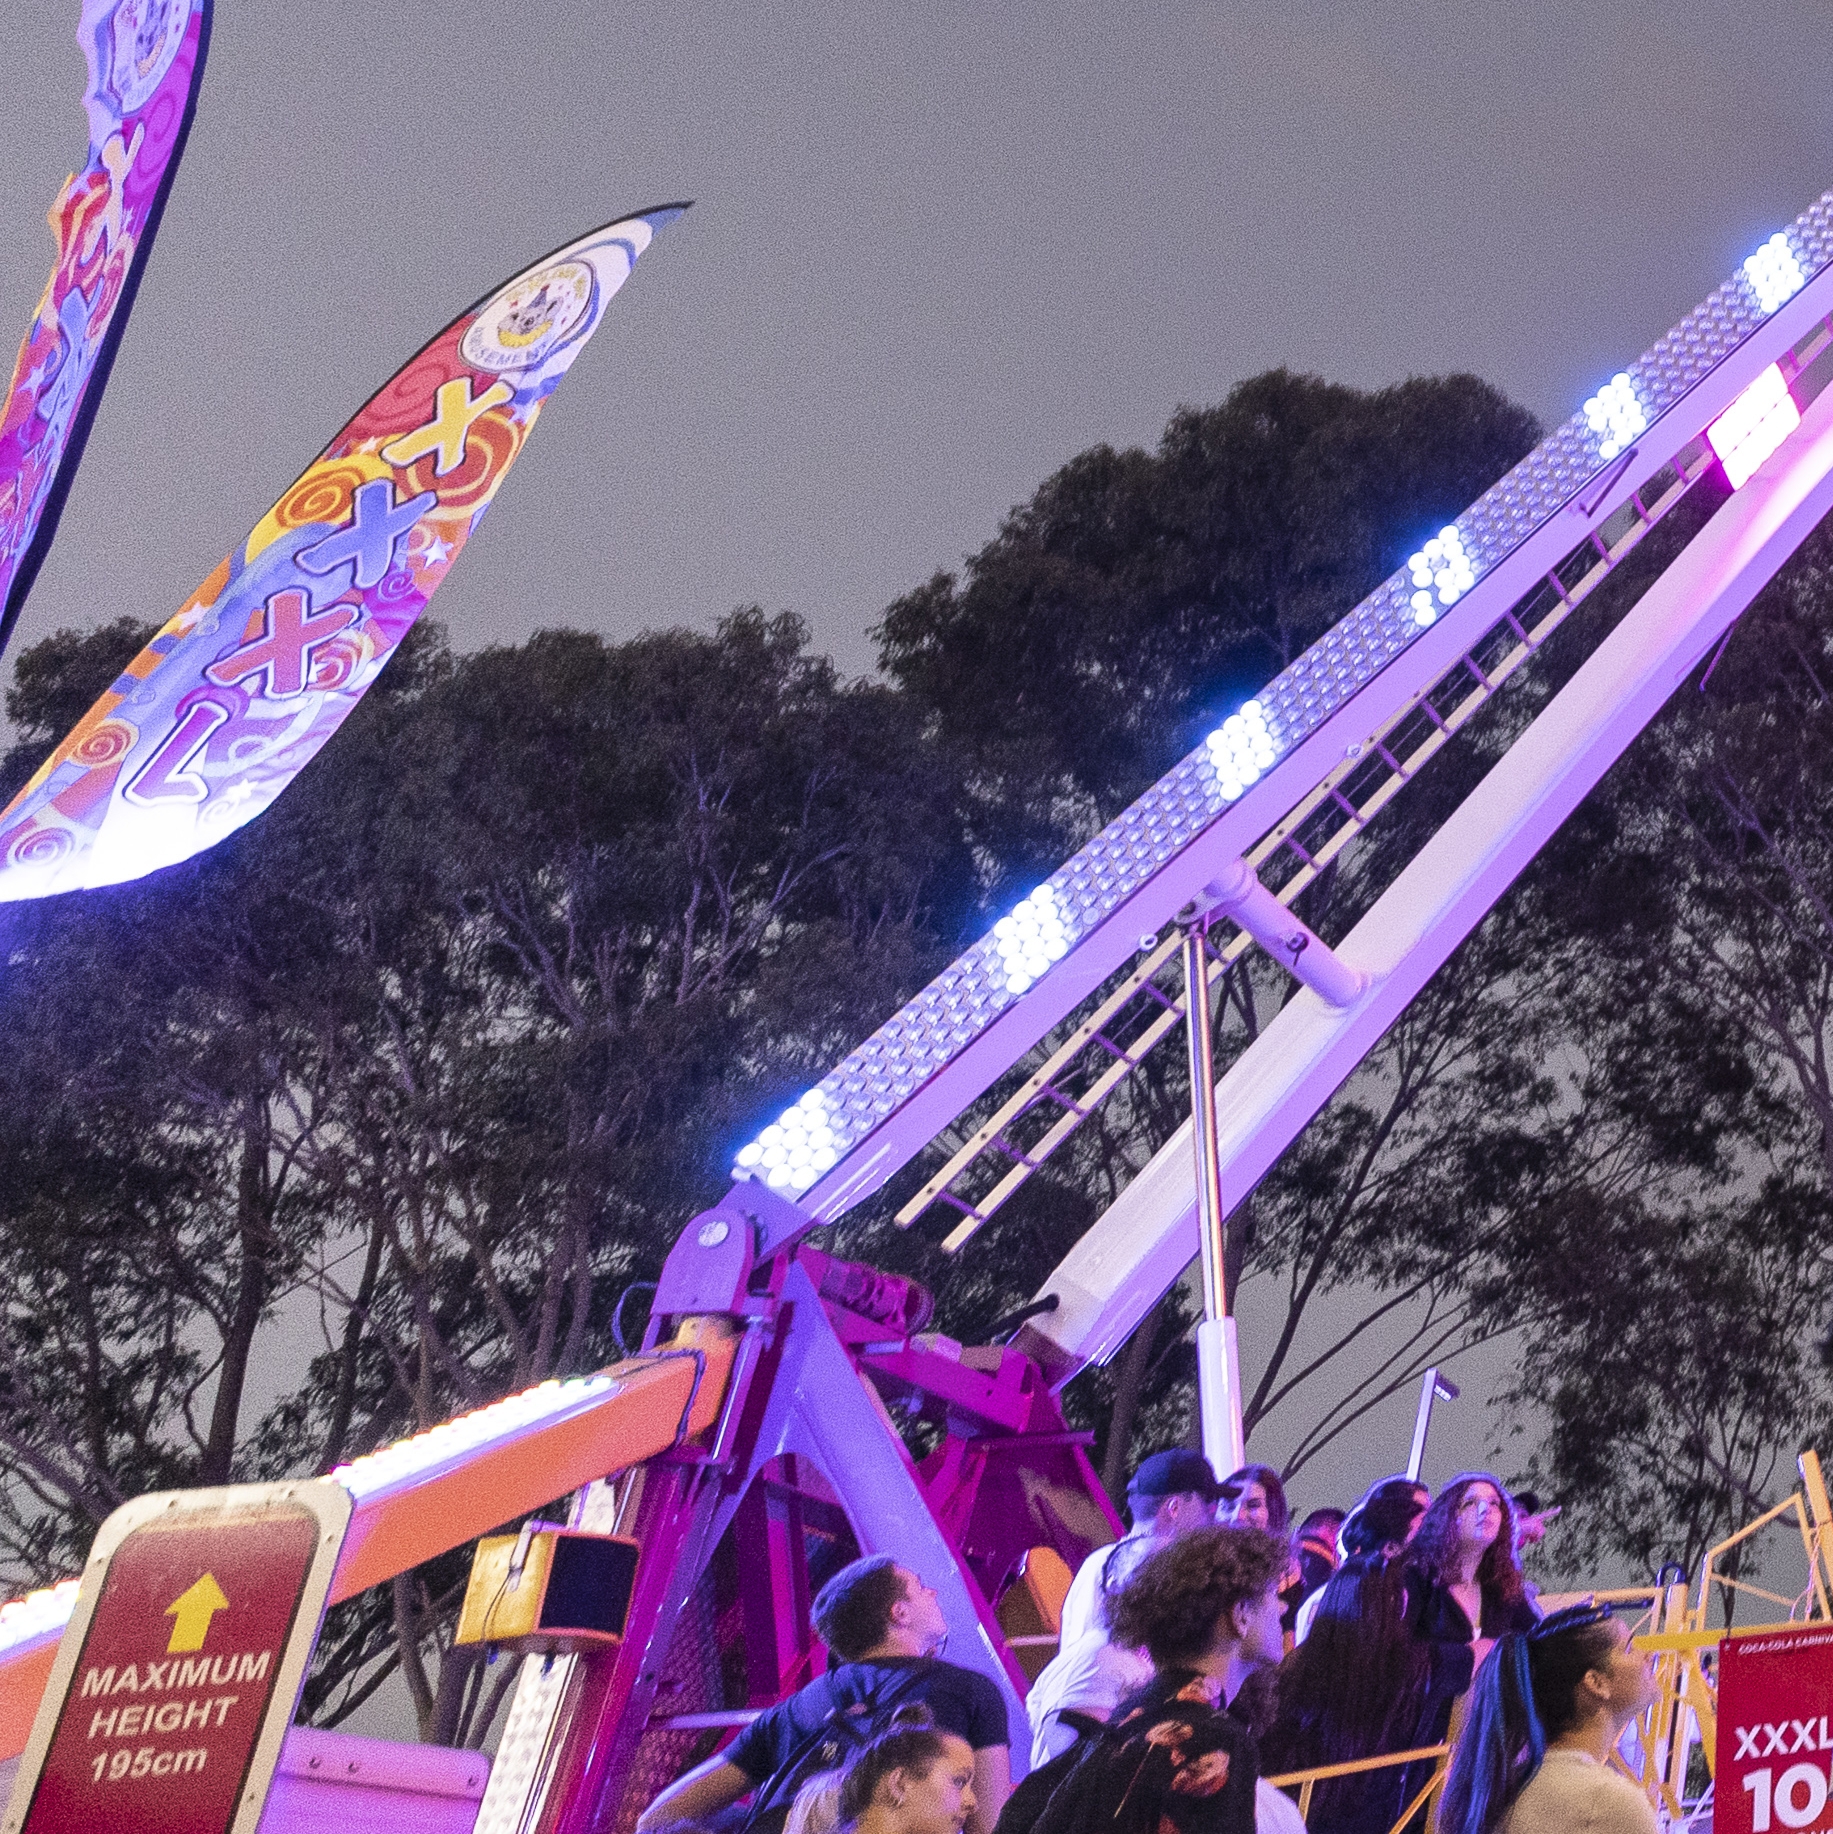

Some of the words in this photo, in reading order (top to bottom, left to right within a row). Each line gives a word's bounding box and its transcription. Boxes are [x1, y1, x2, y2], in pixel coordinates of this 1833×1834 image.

[122, 374, 516, 806] XXXL
[81, 1650, 272, 1698] MAXIMUM
[87, 1695, 239, 1739] HEIGHT
[91, 1747, 209, 1783] 195cm
[1742, 1762, 1828, 1834] 10
